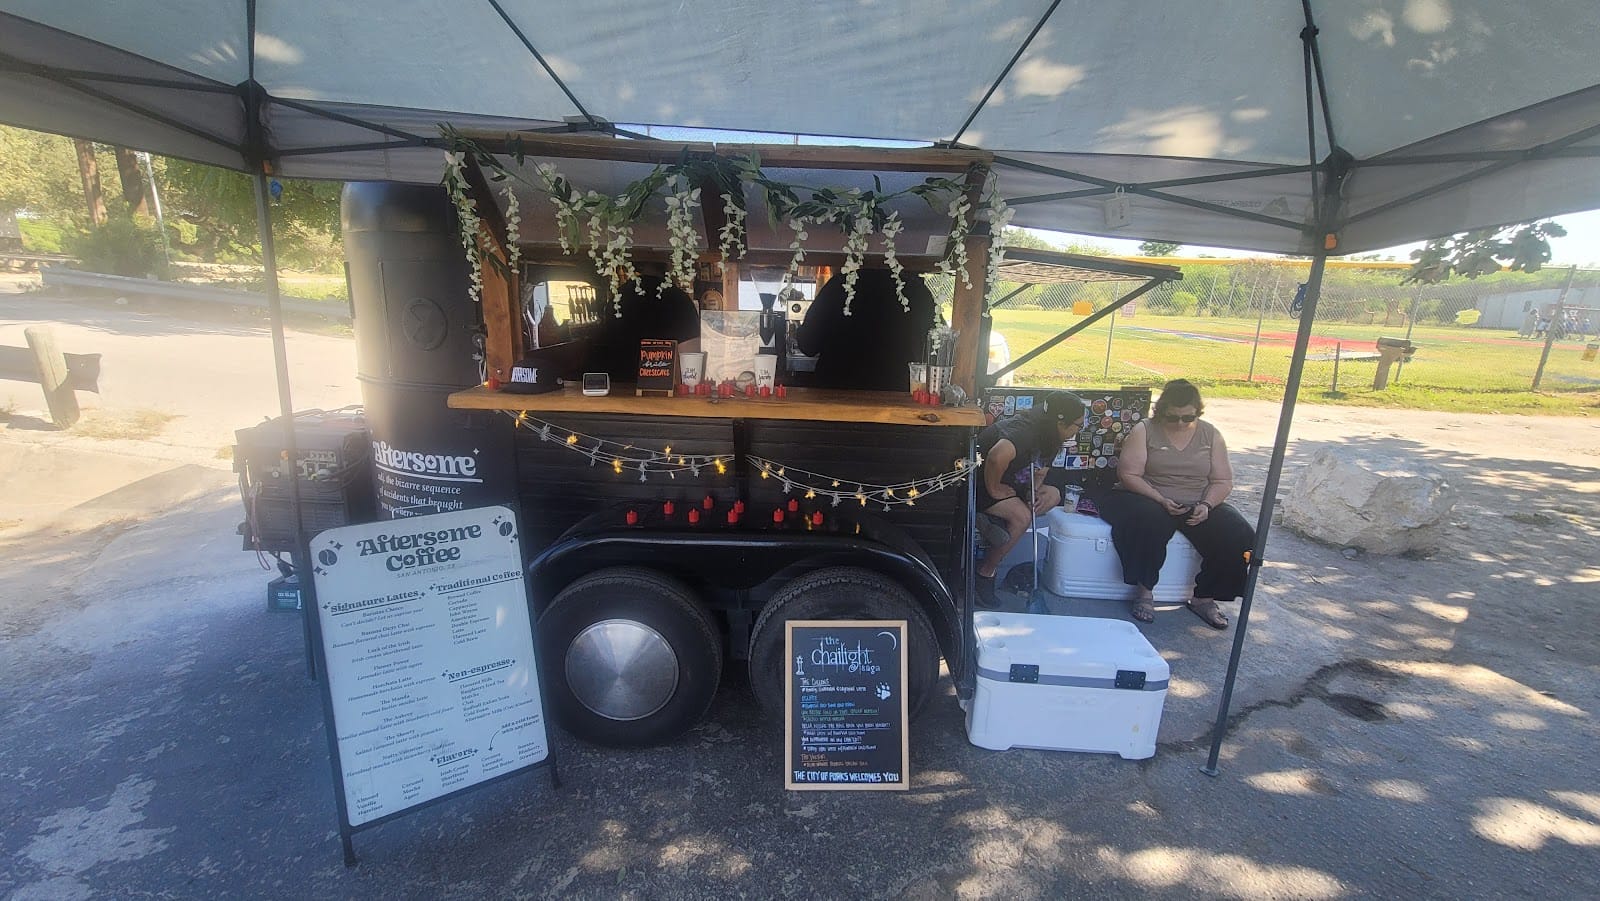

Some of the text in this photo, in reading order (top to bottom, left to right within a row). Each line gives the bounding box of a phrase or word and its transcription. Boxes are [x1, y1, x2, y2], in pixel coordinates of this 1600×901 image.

[640, 350, 673, 361] PUMPKIN
[373, 440, 477, 476] Aftersome
[395, 477, 420, 490] bizarre
[422, 483, 461, 495] sequence
[384, 488, 410, 503] accidents
[410, 494, 427, 506] that
[428, 496, 463, 510] brought
[356, 524, 482, 556] Aftersome
[386, 546, 461, 572] Coffee
[435, 570, 521, 592] Traditional Coffee
[330, 590, 419, 613] Signature Lattes
[825, 636, 840, 645] the
[447, 658, 511, 680] Non-espresso
[436, 748, 473, 765] Flavors
[794, 770, 899, 783] THE CITY OF FORKS WELCOMES YOU
